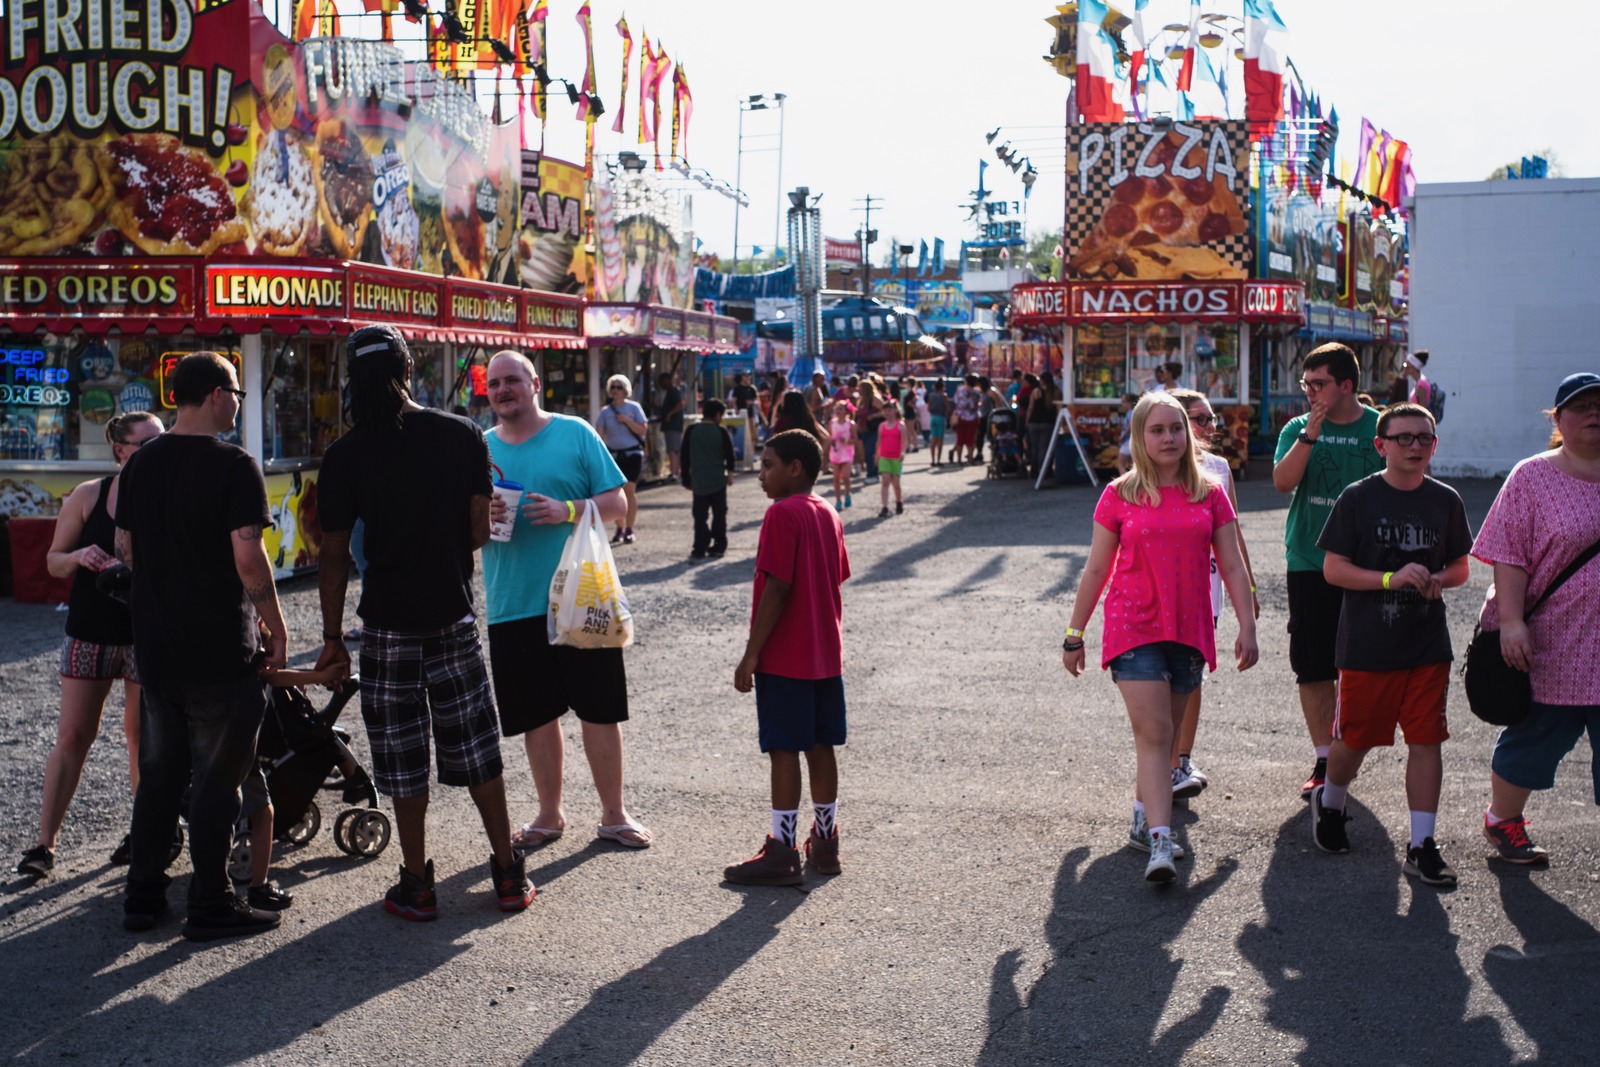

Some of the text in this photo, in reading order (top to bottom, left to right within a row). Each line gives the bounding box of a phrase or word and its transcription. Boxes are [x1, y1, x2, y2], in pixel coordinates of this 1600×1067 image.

[10, 0, 193, 60] FRIED
[304, 42, 412, 106] FUNNEL
[1079, 123, 1237, 194] PIZZA
[372, 164, 410, 207] OREO
[57, 274, 178, 305] OREOS
[216, 275, 342, 307] LEMONADE
[353, 282, 438, 317] ELEPHANT EARS
[1082, 289, 1229, 312] NACHOS
[1248, 287, 1277, 312] COLD
[452, 294, 516, 324] FRIED DOUGH
[527, 305, 555, 327] FUNNEL
[15, 367, 70, 383] FRIED
[1310, 496, 1326, 506] HIGH
[1375, 525, 1440, 547] LEAVE THIS
[582, 626, 608, 636] ROLL
[585, 617, 609, 629] AND
